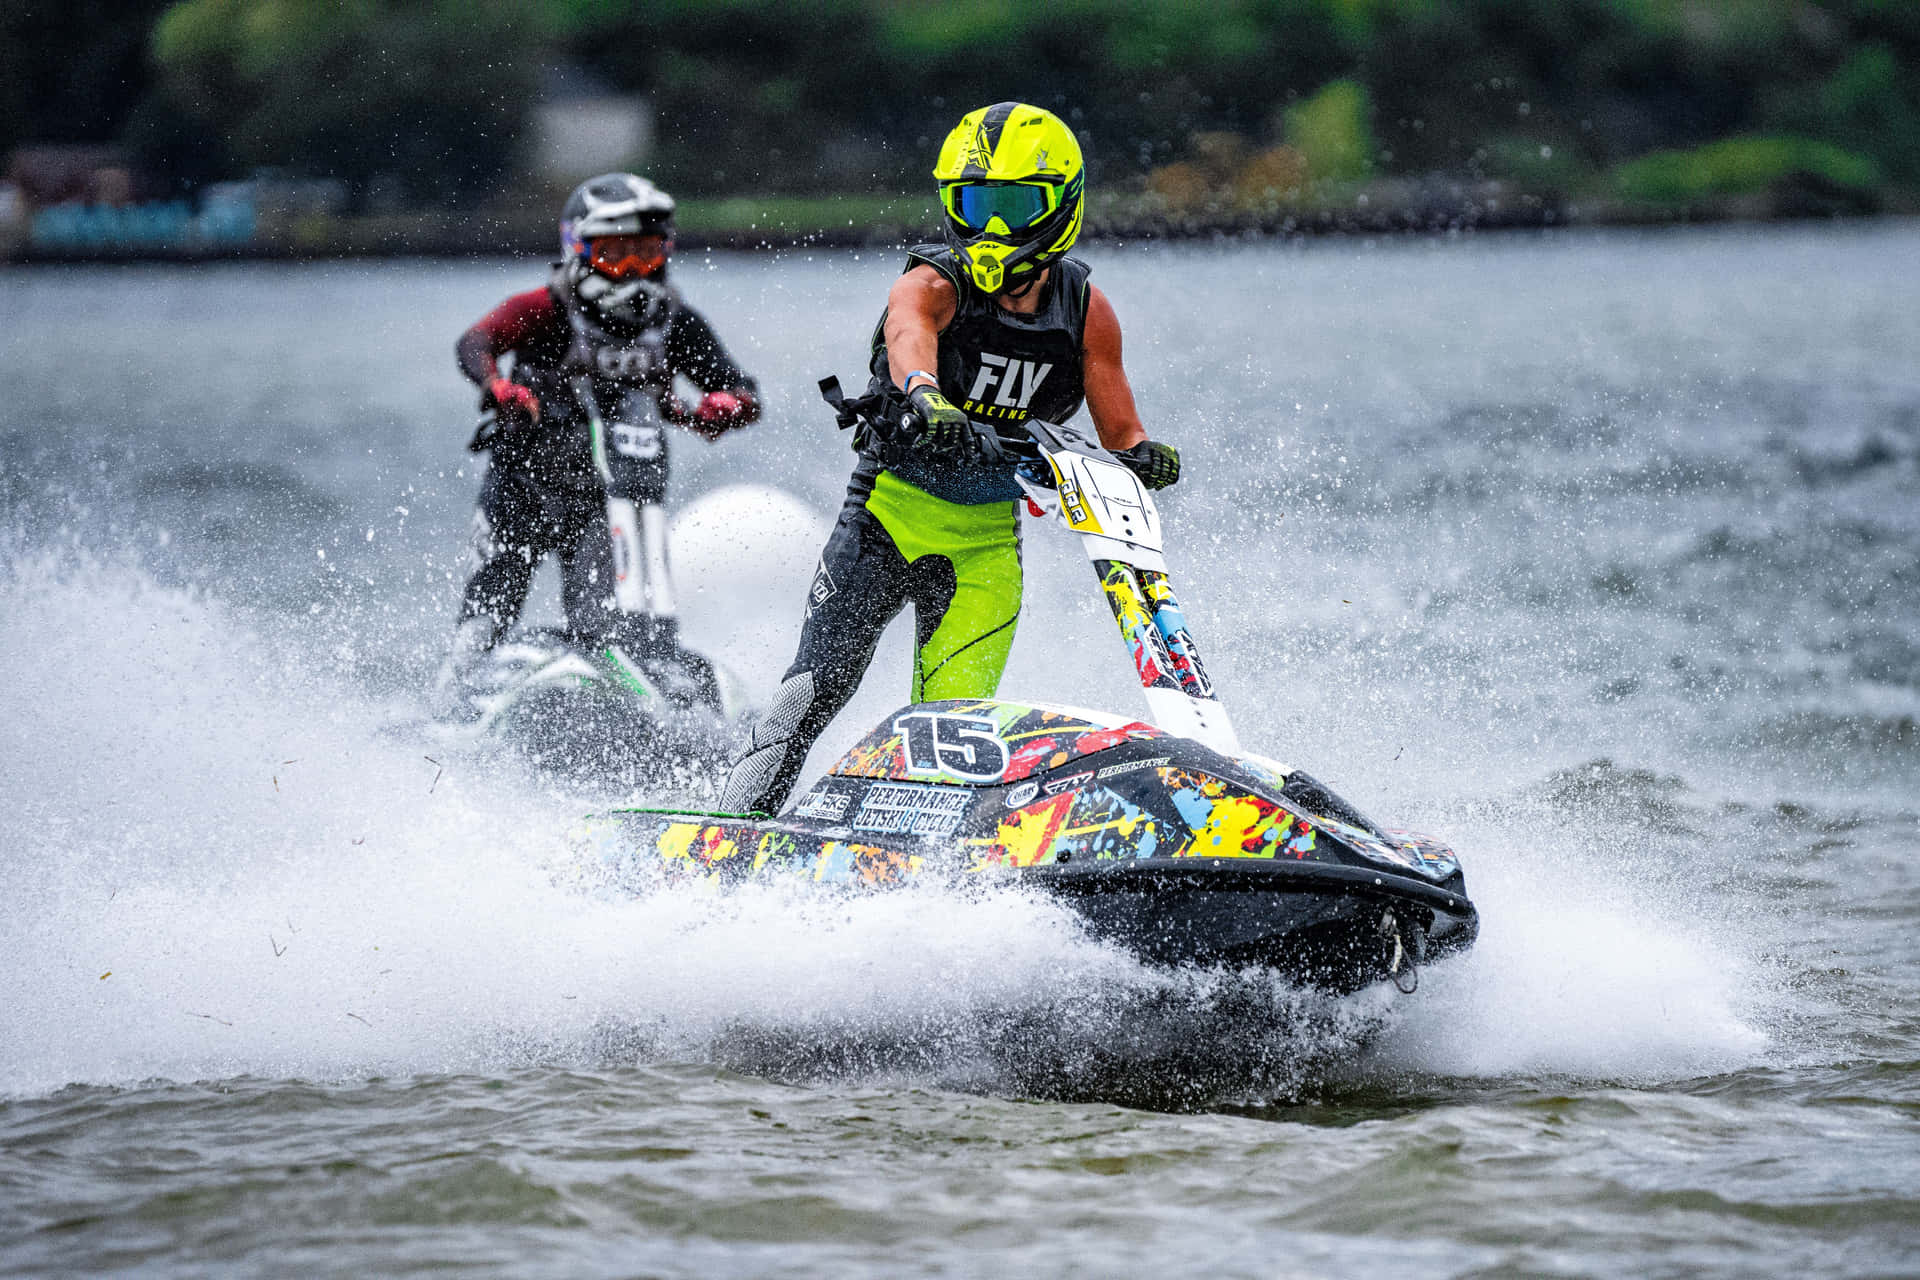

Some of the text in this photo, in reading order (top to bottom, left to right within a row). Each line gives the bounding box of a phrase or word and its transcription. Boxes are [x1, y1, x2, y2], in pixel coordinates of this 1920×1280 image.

[968, 352, 1053, 409] FLY
[963, 400, 1027, 420] RACING
[893, 711, 1008, 781] 15
[864, 787, 969, 811] PERFORMANCE
[855, 808, 904, 830] JETSKI
[914, 812, 960, 834] CYCLE
